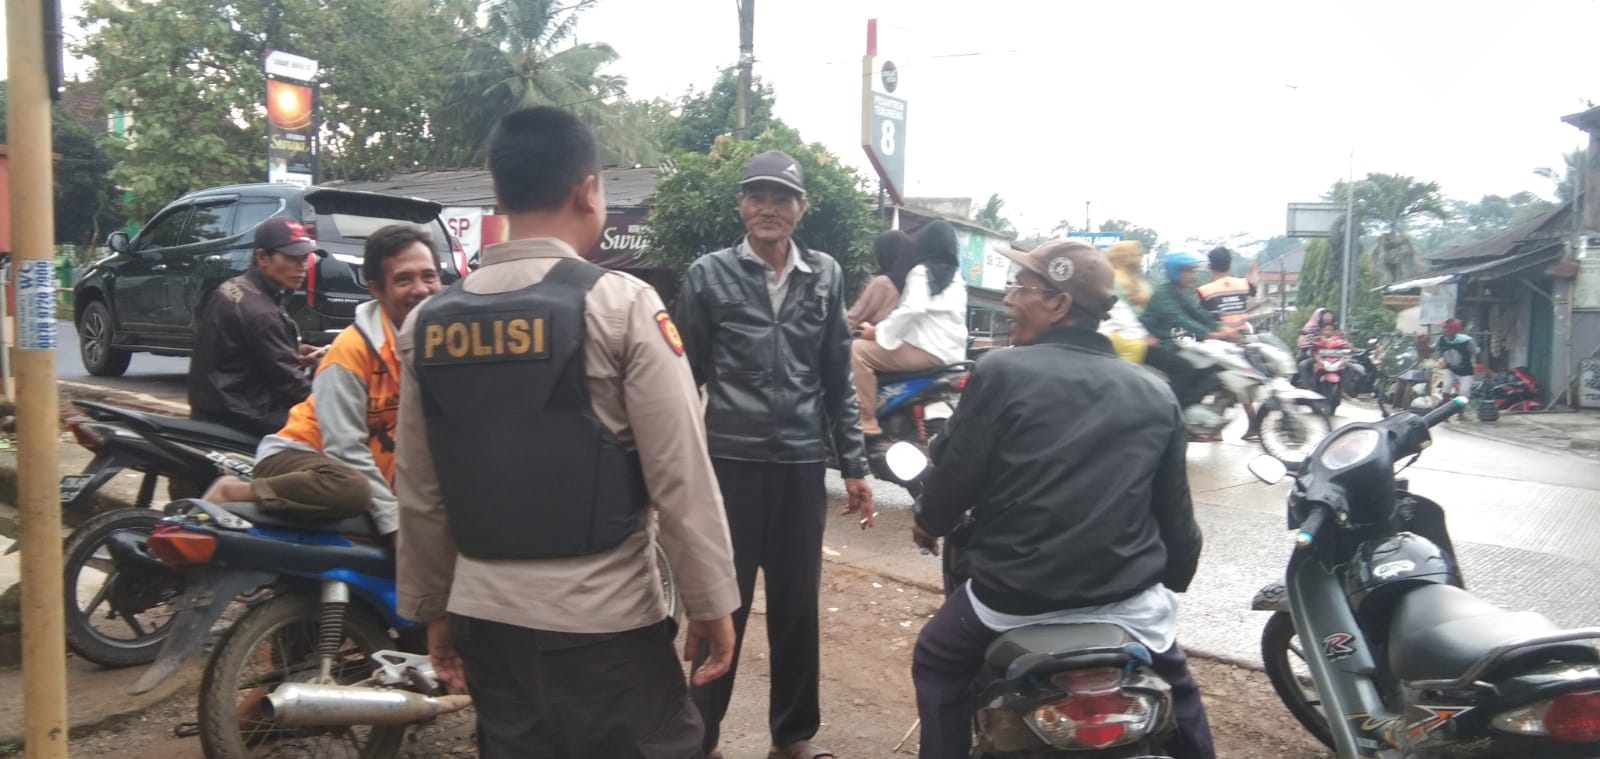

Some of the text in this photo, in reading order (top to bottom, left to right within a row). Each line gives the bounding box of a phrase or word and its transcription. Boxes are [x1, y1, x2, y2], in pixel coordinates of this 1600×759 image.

[881, 120, 895, 156] 8
[19, 262, 33, 290] WC
[424, 318, 544, 359] POLISI
